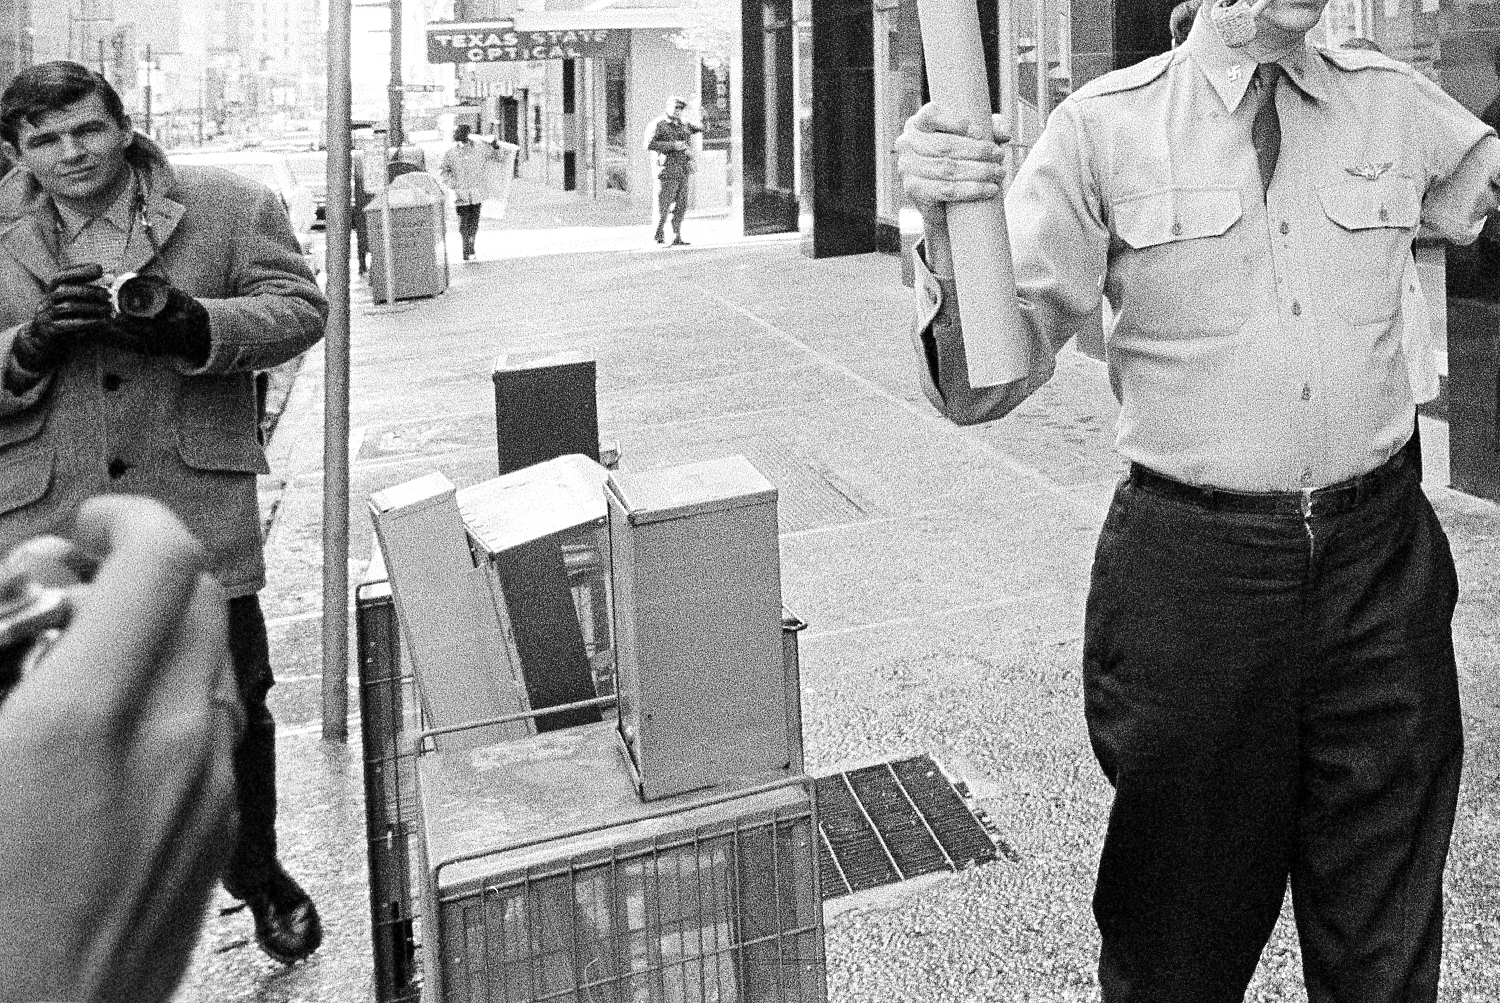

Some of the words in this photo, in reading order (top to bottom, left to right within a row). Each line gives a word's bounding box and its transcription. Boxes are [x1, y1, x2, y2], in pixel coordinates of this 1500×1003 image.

[435, 32, 518, 47] TEXAS
[531, 30, 608, 45] STATE
[467, 46, 582, 62] OPTICAL
